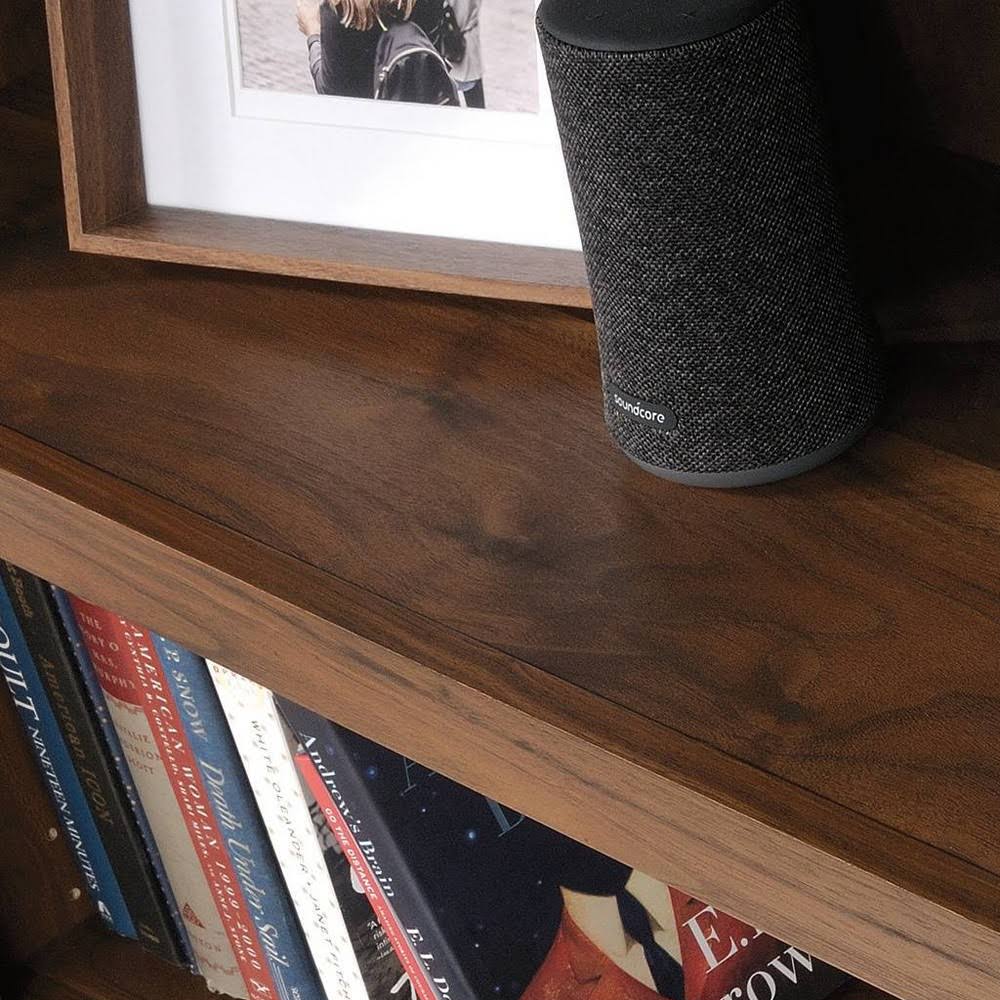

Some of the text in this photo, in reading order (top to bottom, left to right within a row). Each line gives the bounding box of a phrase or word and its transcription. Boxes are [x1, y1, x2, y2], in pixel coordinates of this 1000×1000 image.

[614, 394, 665, 423] soundcore
[130, 624, 185, 753] AMERICAN
[181, 765, 220, 850] WOMAN
[171, 669, 209, 743] SNOW
[201, 760, 242, 831] Death
[228, 838, 266, 916] Under
[256, 917, 290, 967] Sail
[250, 719, 278, 776] WHITE
[272, 782, 309, 874] OLEANDER
[300, 733, 361, 834] Andrew's
[359, 840, 395, 897] Brain
[406, 928, 424, 947] E.
[420, 952, 435, 972] L.
[324, 807, 337, 824] GO
[334, 826, 349, 851] THE
[347, 848, 378, 901] DISTANCE
